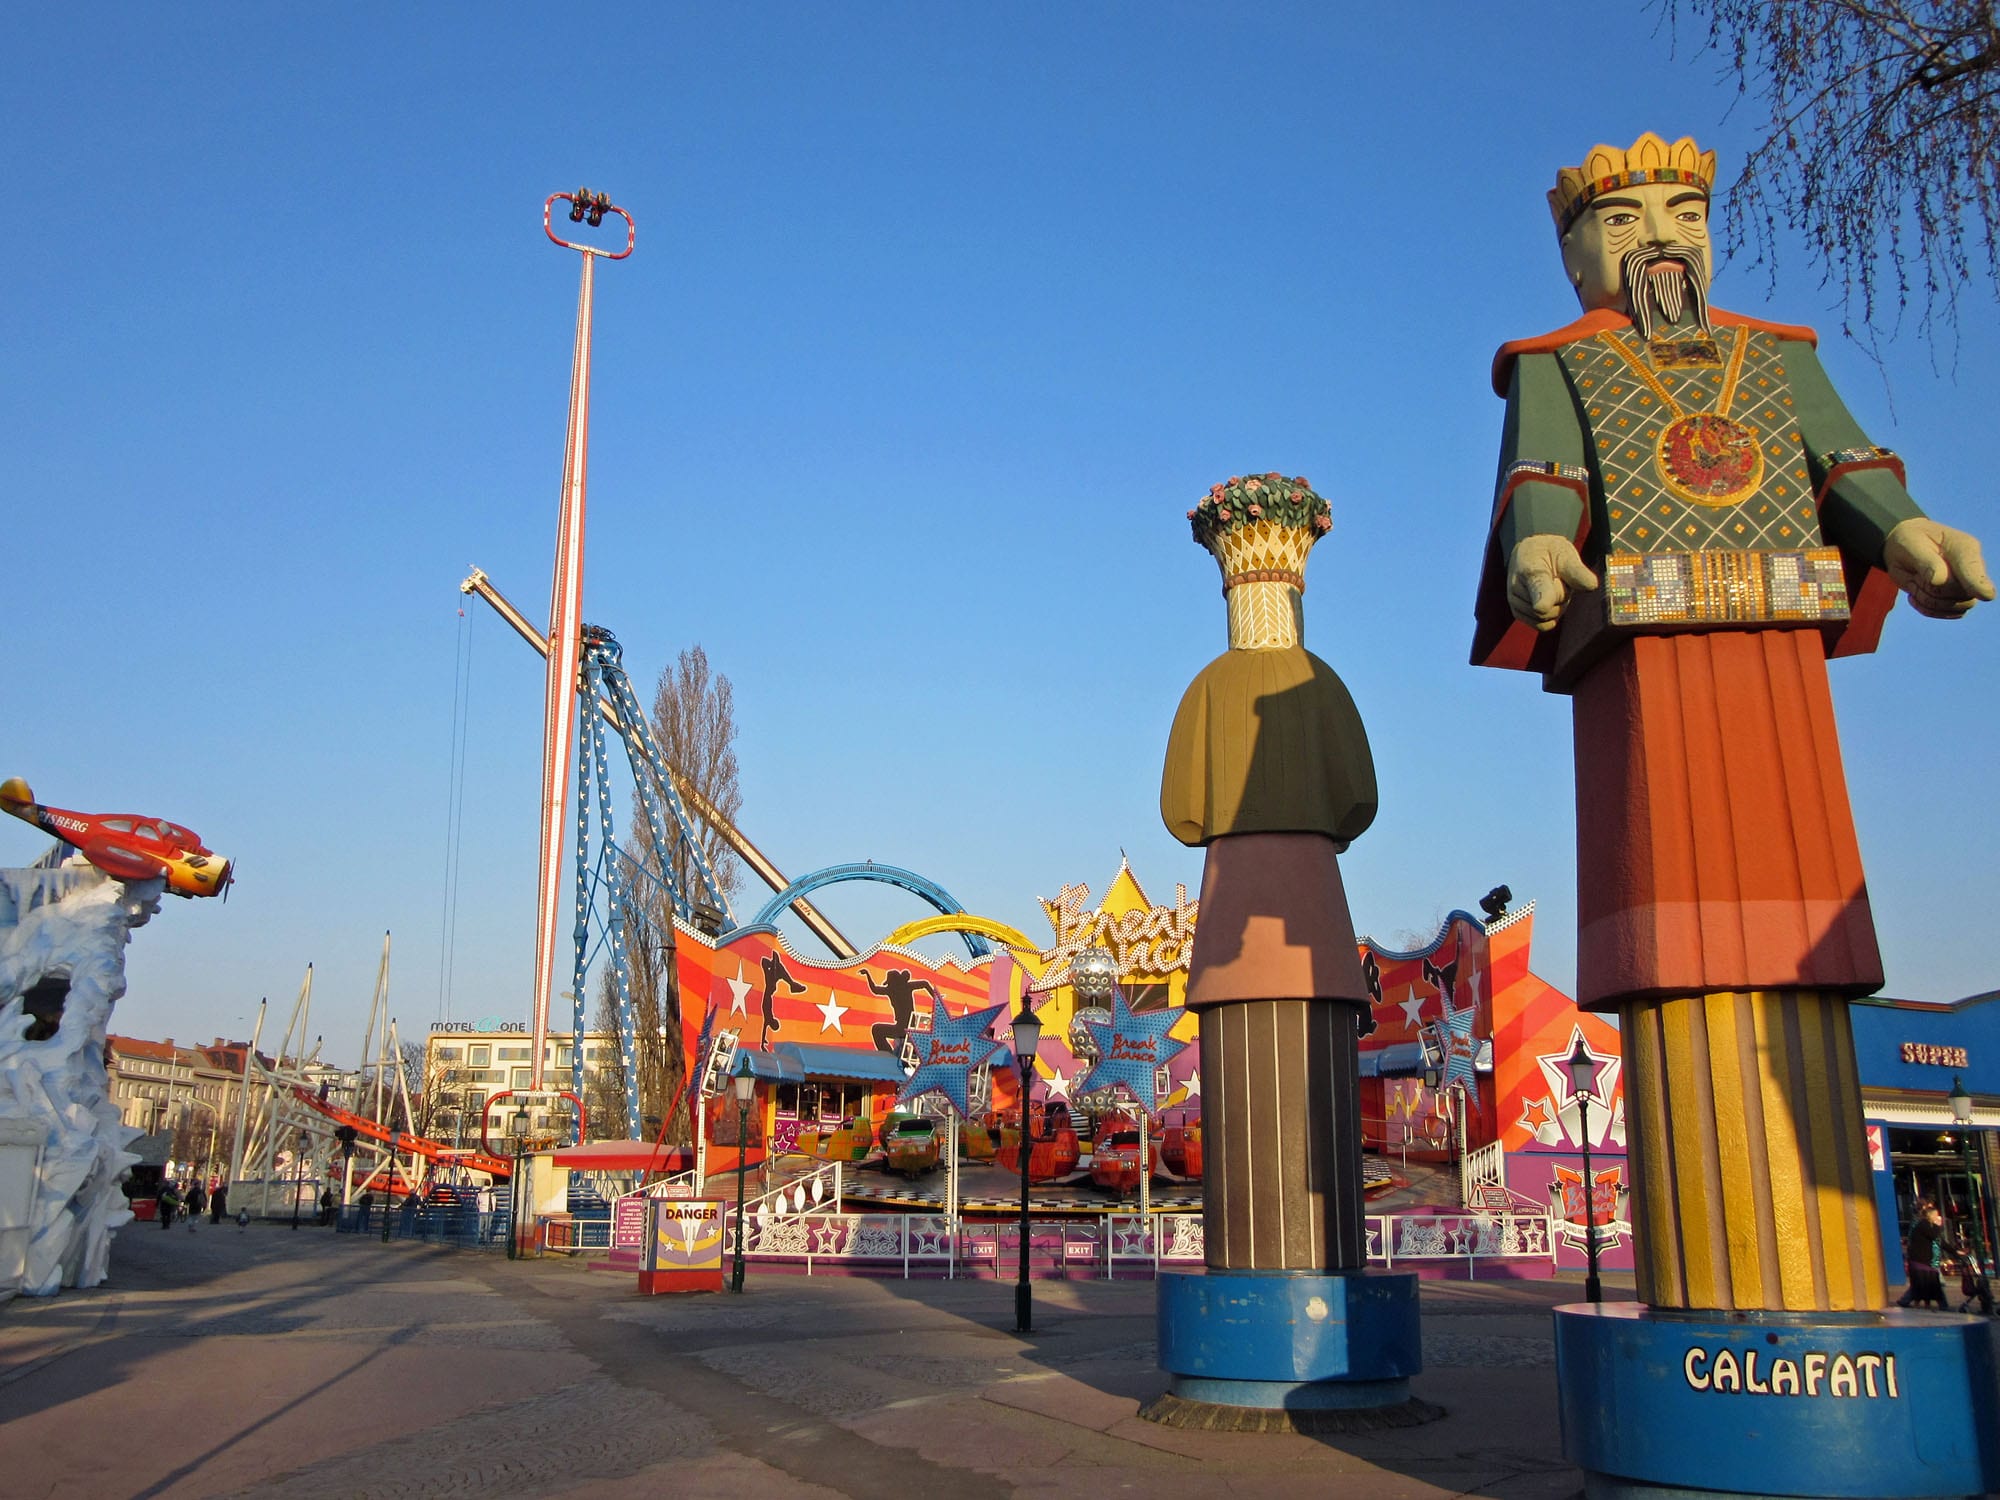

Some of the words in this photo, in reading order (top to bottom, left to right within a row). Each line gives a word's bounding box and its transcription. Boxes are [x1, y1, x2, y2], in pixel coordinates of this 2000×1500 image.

[930, 1038, 970, 1054] Break
[1112, 1033, 1157, 1051] Break
[927, 1054, 970, 1067] Dance
[1108, 1050, 1156, 1062] Dance
[1900, 1042, 1969, 1068] SUPER
[666, 1208, 719, 1220] DANGER
[761, 1217, 810, 1240] Break
[847, 1217, 899, 1241] Break
[1401, 1218, 1446, 1240] Break
[755, 1234, 810, 1254] Dance
[841, 1236, 899, 1255] Dance
[972, 1246, 993, 1254] EXIT
[1068, 1247, 1089, 1255] EXIT
[1397, 1237, 1446, 1255] Dance
[1684, 1347, 1899, 1400] CALAFATI
